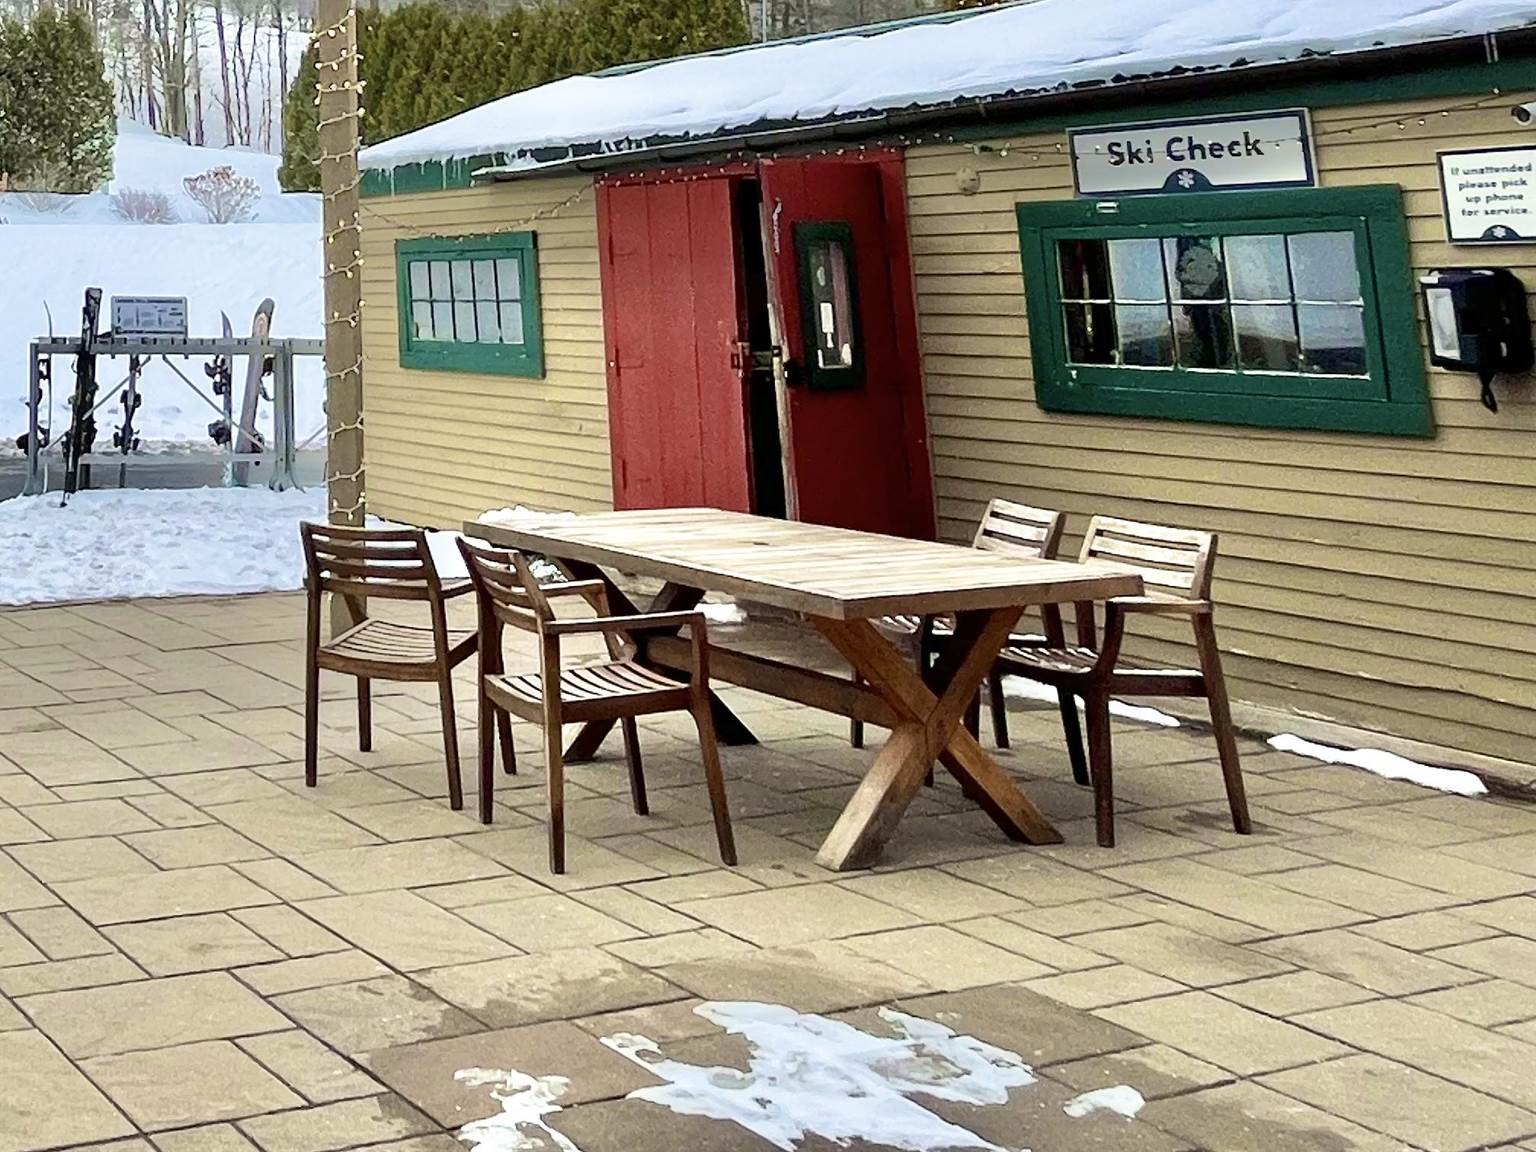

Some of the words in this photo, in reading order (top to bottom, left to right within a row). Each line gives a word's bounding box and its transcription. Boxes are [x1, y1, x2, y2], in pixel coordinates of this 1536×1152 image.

[1107, 140, 1154, 166] Ski
[1166, 132, 1265, 163] Check
[1463, 162, 1532, 175] unattended
[1458, 181, 1497, 191] please
[1501, 178, 1528, 189] pick
[1465, 195, 1481, 204] up
[1485, 194, 1524, 204] phone
